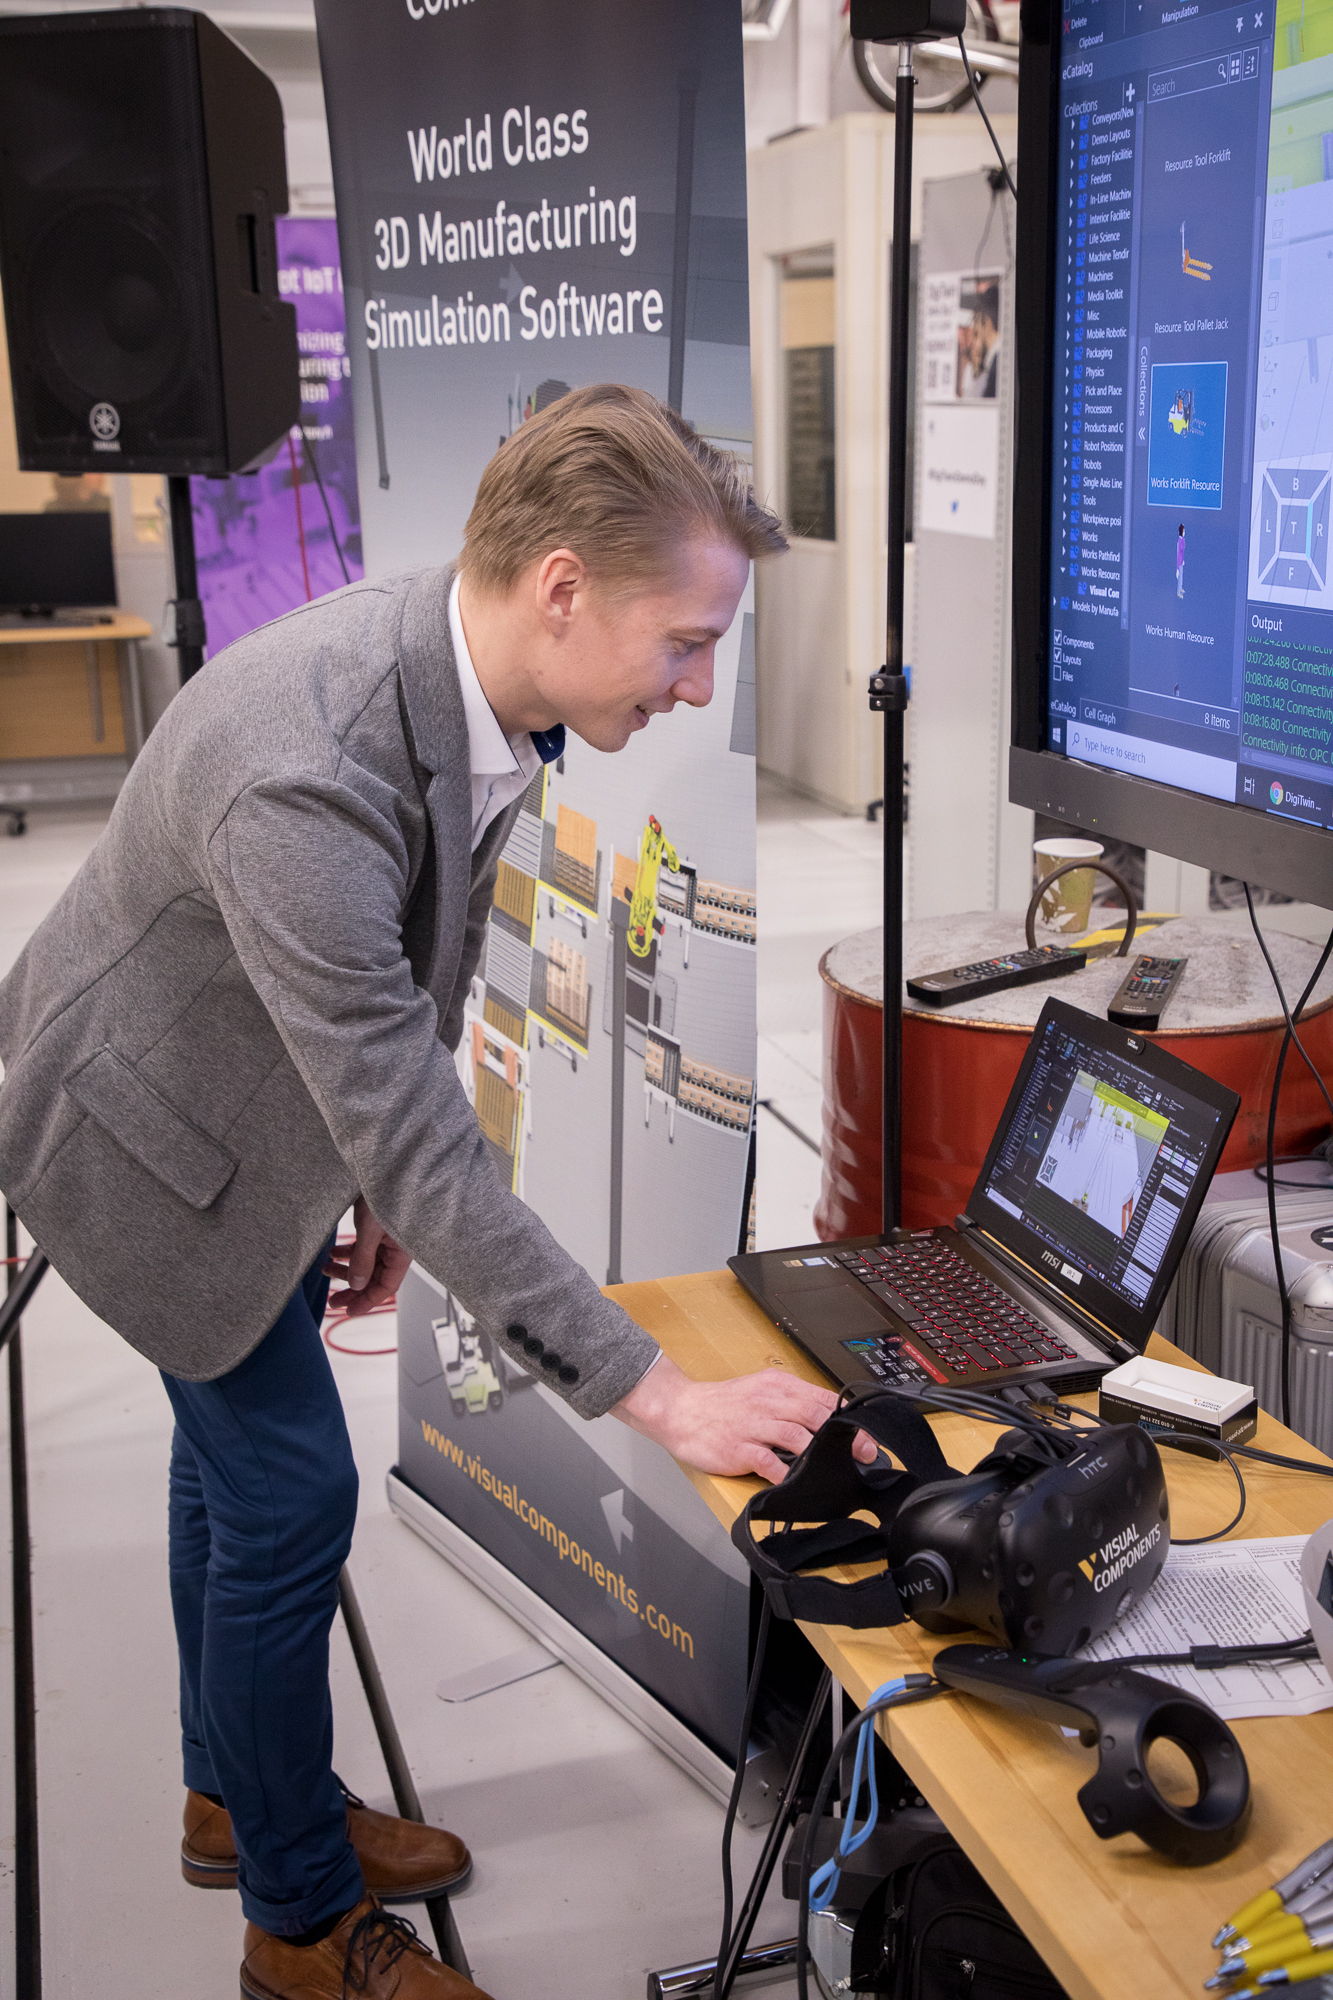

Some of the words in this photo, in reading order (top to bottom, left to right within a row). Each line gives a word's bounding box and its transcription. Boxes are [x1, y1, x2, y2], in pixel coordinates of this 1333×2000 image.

[1162, 4, 1199, 24] Manipulation
[1071, 17, 1088, 29] Delete
[1079, 32, 1104, 49] Clipboard
[1062, 61, 1093, 80] eCatalog
[1152, 78, 1176, 97] Search
[1064, 100, 1098, 118] Collections
[407, 113, 493, 184] World
[502, 104, 590, 167] Class
[1092, 134, 1109, 146] Demo
[1109, 128, 1131, 143] Layouts
[1091, 154, 1111, 166] Factory
[1164, 158, 1193, 172] Resource
[1194, 152, 1208, 167] Tool
[1208, 148, 1231, 164] Forklift
[1090, 172, 1112, 185] Feeders
[1090, 193, 1109, 205] In-Line
[1089, 212, 1109, 225] Interior
[374, 216, 410, 271] 3D
[418, 185, 638, 266] Manufacturing
[1089, 233, 1099, 245] Life
[1100, 231, 1121, 243] Science
[1088, 250, 1112, 263] Machine
[1088, 270, 1114, 282] Machines
[1087, 290, 1104, 302] Media
[1105, 288, 1124, 300] Toolkit
[364, 290, 512, 350] Simulation
[519, 281, 665, 341] Software
[1087, 310, 1100, 321] Misc
[1086, 328, 1105, 339] Mobile
[1105, 326, 1127, 338] Robotic
[1154, 322, 1182, 334] Resource
[1183, 320, 1196, 332] Tool
[1197, 318, 1214, 331] Pallet
[1214, 317, 1229, 330] Jack
[1086, 347, 1113, 360] Packaging
[1085, 366, 1105, 380] Physics
[1139, 346, 1148, 416] Collections
[1085, 385, 1096, 396] Pick
[1096, 385, 1107, 396] and
[1107, 384, 1122, 396] Place
[1084, 403, 1113, 415] Processors
[1084, 422, 1107, 433] Products
[1107, 422, 1119, 433] and
[1084, 440, 1100, 452] Robot
[1083, 459, 1102, 470] Robots
[1082, 476, 1099, 489] Single
[1099, 478, 1111, 489] Axis
[1111, 478, 1123, 489] Line
[1150, 477, 1169, 489] Works
[1170, 478, 1190, 490] Forklift
[1191, 479, 1220, 491] Resource
[1292, 477, 1299, 491] B
[1082, 494, 1097, 506] Tools
[1082, 513, 1109, 527] Workpiece
[1109, 516, 1122, 528] posi
[1265, 519, 1271, 533] L
[1290, 521, 1297, 535] T
[1316, 523, 1323, 537] R
[1082, 531, 1098, 542] Works
[1081, 548, 1098, 560] Works
[1098, 550, 1121, 562] Pathfind
[1081, 566, 1097, 578] Works
[1288, 566, 1294, 581] F
[1089, 584, 1107, 597] Visual
[1072, 600, 1091, 612] Models
[1091, 603, 1098, 616] by
[1098, 604, 1119, 617] Manufa
[1251, 614, 1283, 634] Output
[1063, 635, 1095, 650] Components
[1145, 624, 1163, 637] Works
[1164, 628, 1186, 640] Human
[1187, 631, 1215, 645] Resource
[1062, 652, 1082, 666] Layouts
[1246, 650, 1290, 670] 0:07:28.488
[1062, 670, 1073, 682] Files
[1245, 671, 1289, 691] 0:08:06.468
[1050, 700, 1077, 717] eCatalog
[1244, 691, 1285, 712] 0:08:15.142
[1084, 706, 1096, 719] Cell
[1097, 709, 1116, 726] Graph
[1204, 712, 1210, 724] 8
[1210, 713, 1231, 730] Items
[1243, 712, 1281, 731] 0:08:16.80
[1282, 720, 1332, 746] Connectivity
[1084, 737, 1099, 752] Type
[1099, 740, 1115, 755] here
[1115, 745, 1123, 757] to
[1123, 747, 1146, 764] search
[1242, 732, 1289, 757] Connectivity
[1290, 743, 1308, 759] info:
[1309, 747, 1329, 764] OPC
[1285, 791, 1315, 810] DigiTwin
[1041, 1250, 1061, 1269] msi
[421, 1419, 694, 1659] www.visualcomponents.com
[1099, 1523, 1140, 1564] VISUAL
[1094, 1523, 1161, 1593] COMPONENTS
[898, 1578, 935, 1598] VIVE
